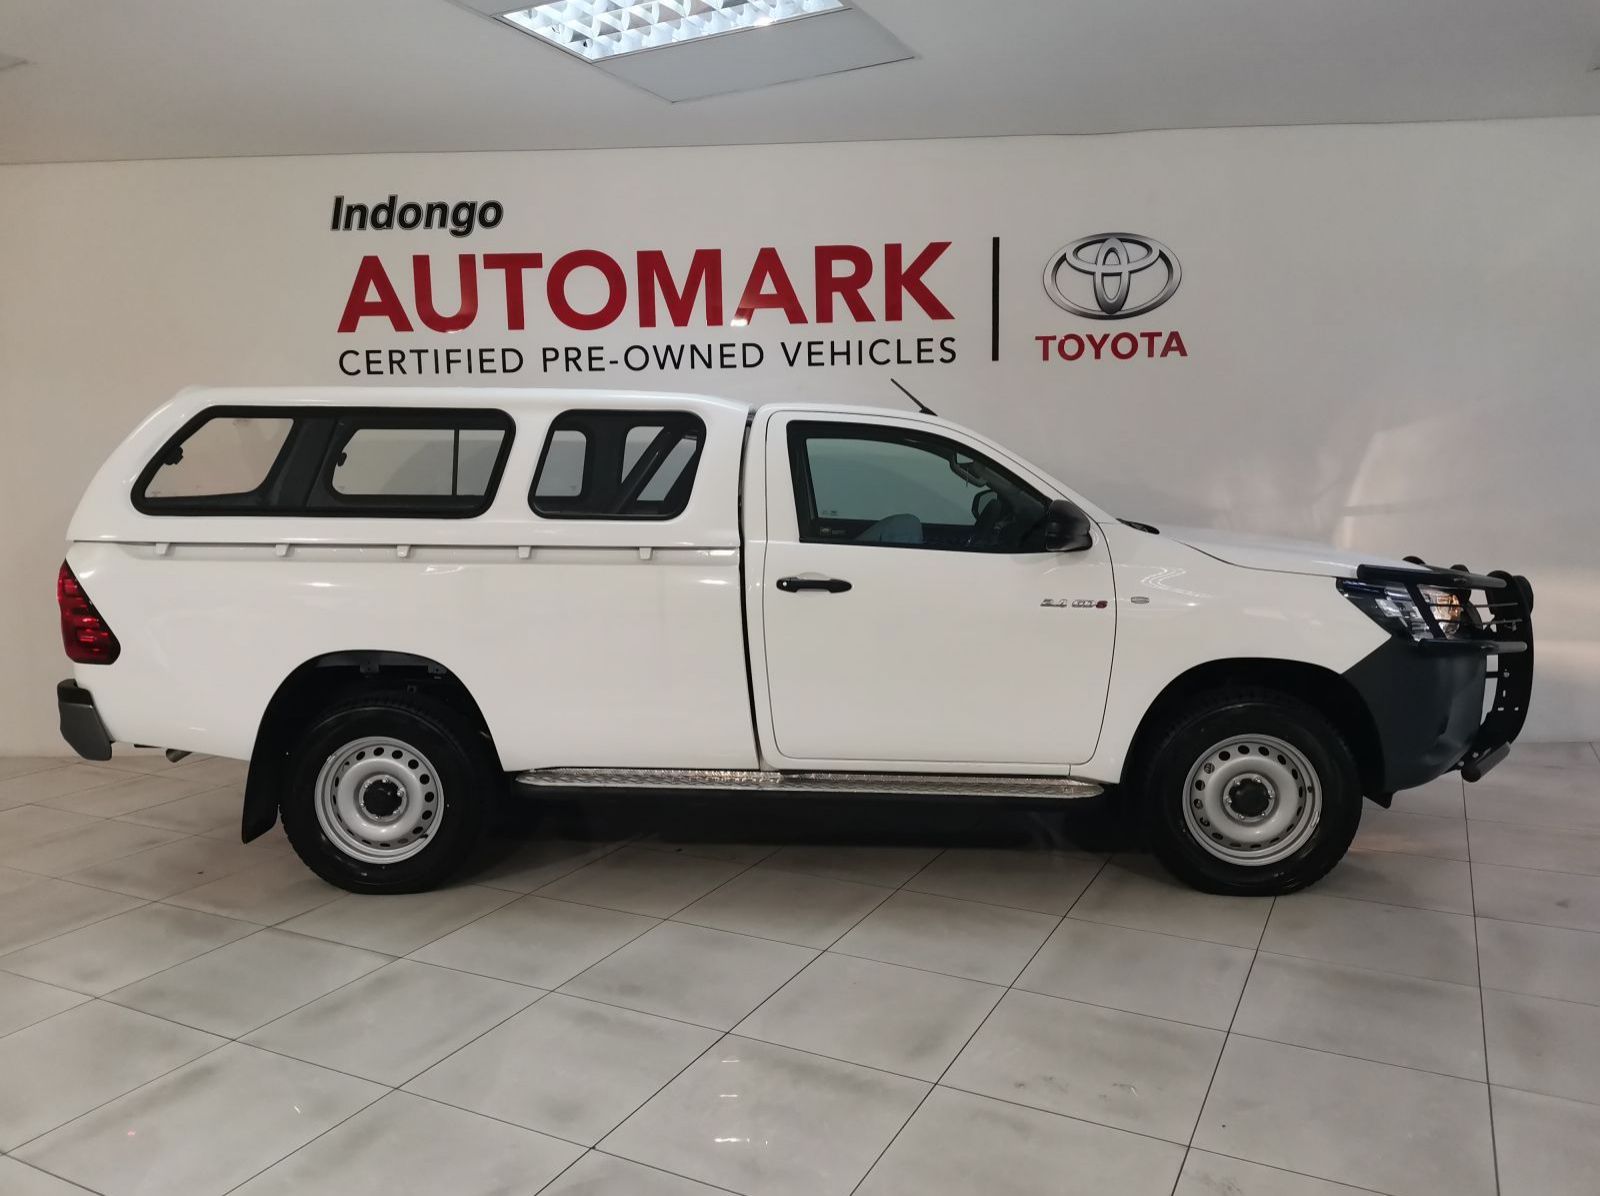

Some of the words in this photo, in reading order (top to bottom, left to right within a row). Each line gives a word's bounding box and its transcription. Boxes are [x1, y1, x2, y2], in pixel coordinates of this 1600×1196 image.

[330, 194, 504, 238] Indongo
[337, 241, 954, 334] AUTOMARK
[338, 348, 524, 376] CERTIFIED
[541, 343, 764, 373] PRE-OWNED
[780, 336, 957, 367] VEHICLES
[1035, 331, 1188, 362] TOYOTA
